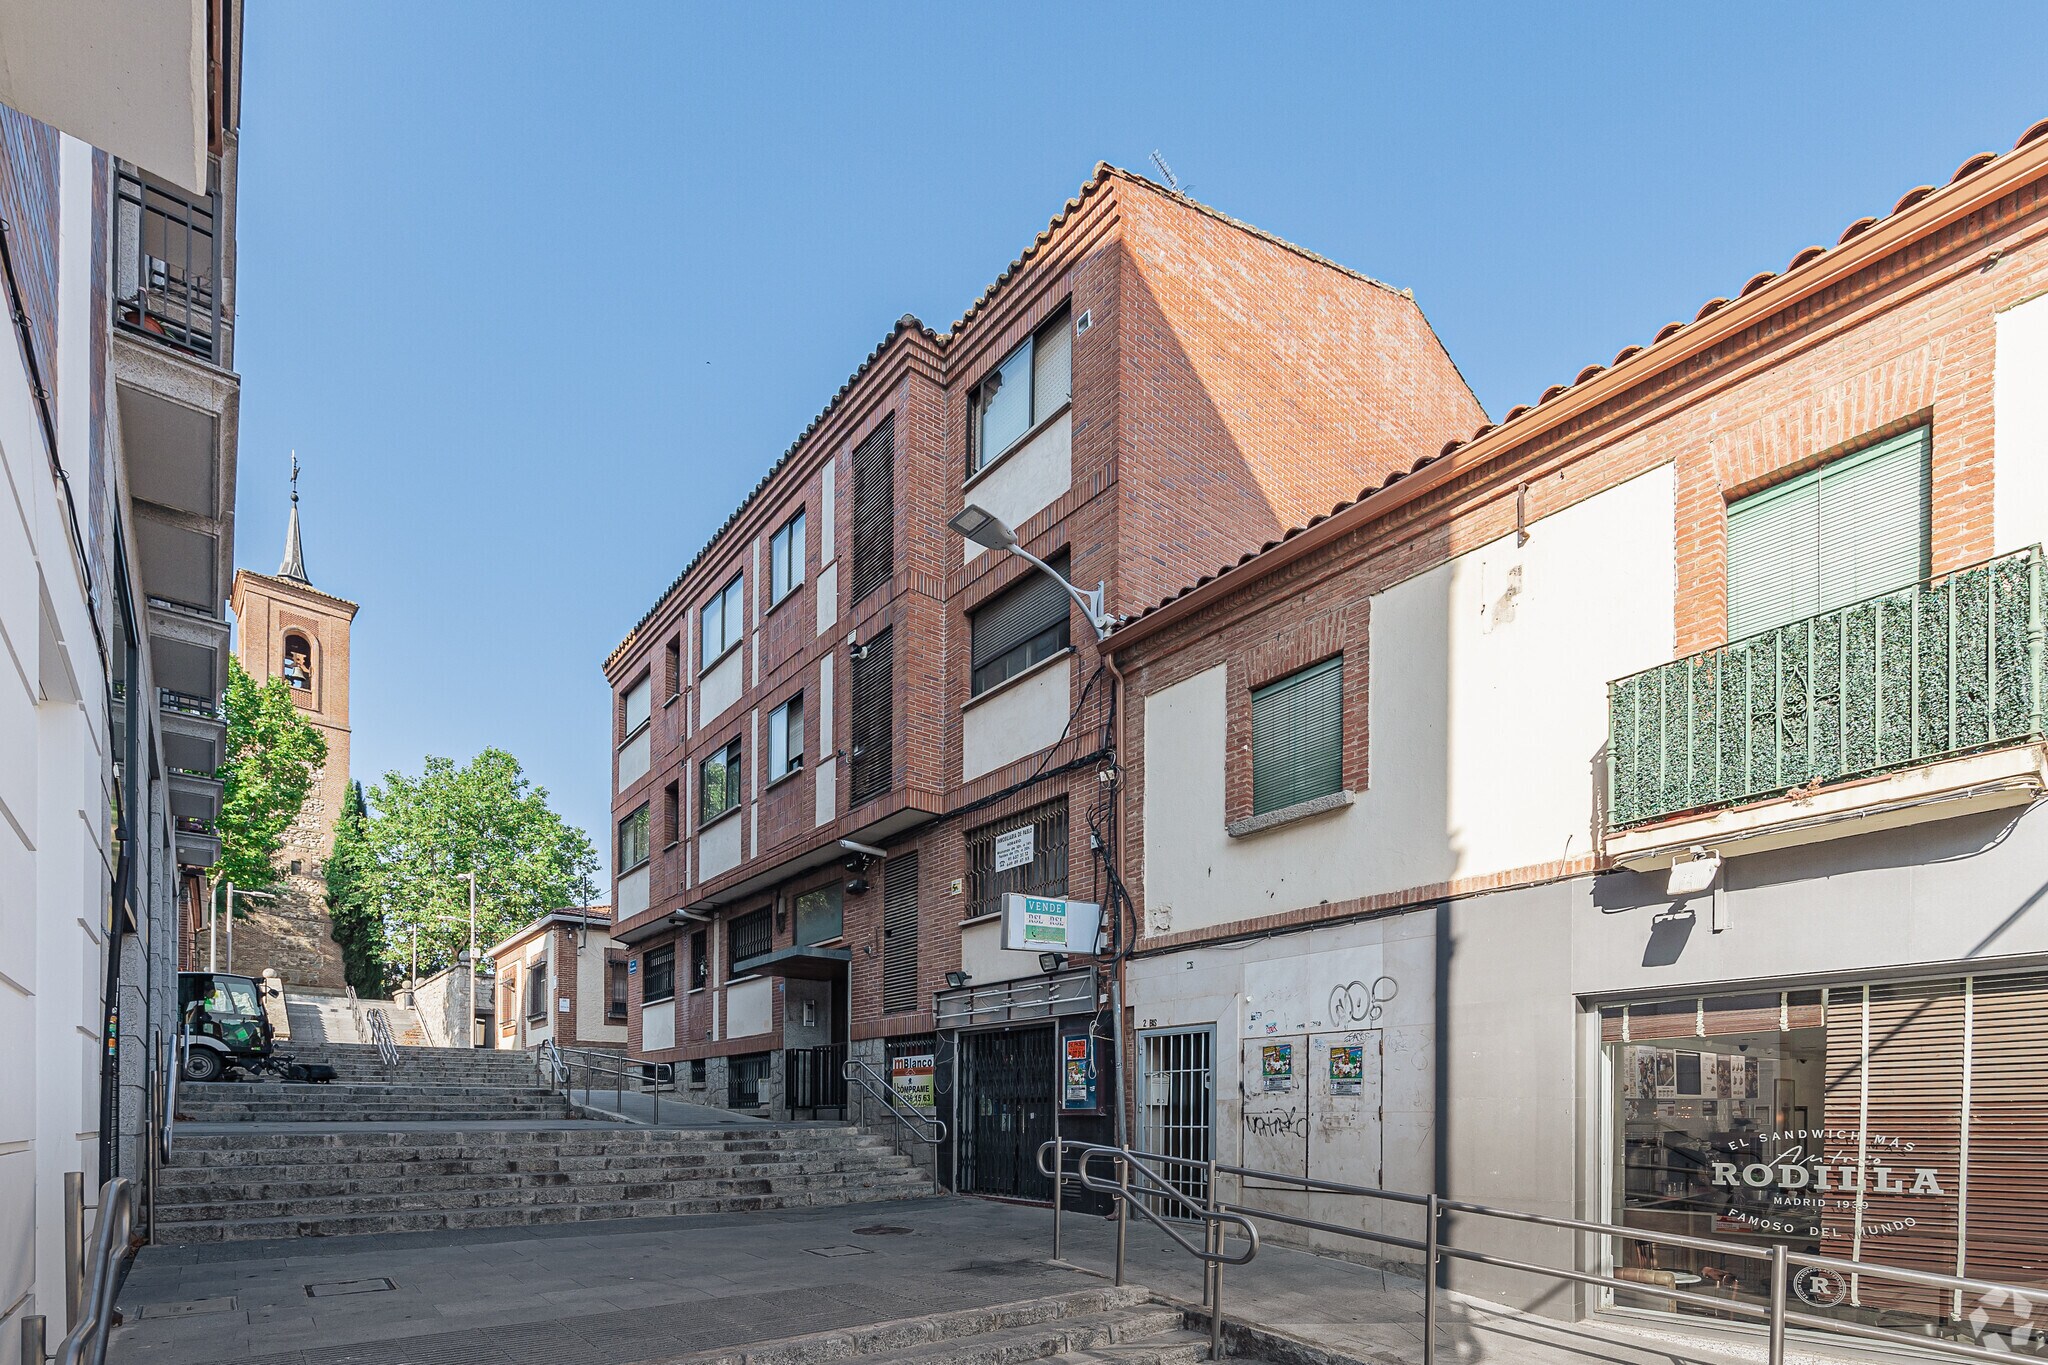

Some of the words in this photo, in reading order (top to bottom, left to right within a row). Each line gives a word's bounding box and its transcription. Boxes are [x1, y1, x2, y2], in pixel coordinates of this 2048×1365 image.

[1028, 900, 1062, 913] VENDE
[1143, 1019, 1146, 1027] 2
[1728, 1138, 1749, 1151] EL
[1759, 1129, 1861, 1142] SANDWICH
[1874, 1134, 1916, 1152] MÁS
[1712, 1162, 1944, 1194] RODILLA
[1773, 1197, 1826, 1207] MADRID
[1836, 1200, 1869, 1210] 1939
[1728, 1208, 1794, 1233] FAMOSO
[1810, 1226, 1841, 1237] DEL
[1857, 1217, 1916, 1235] MUNDO
[1810, 1276, 1830, 1294] R
